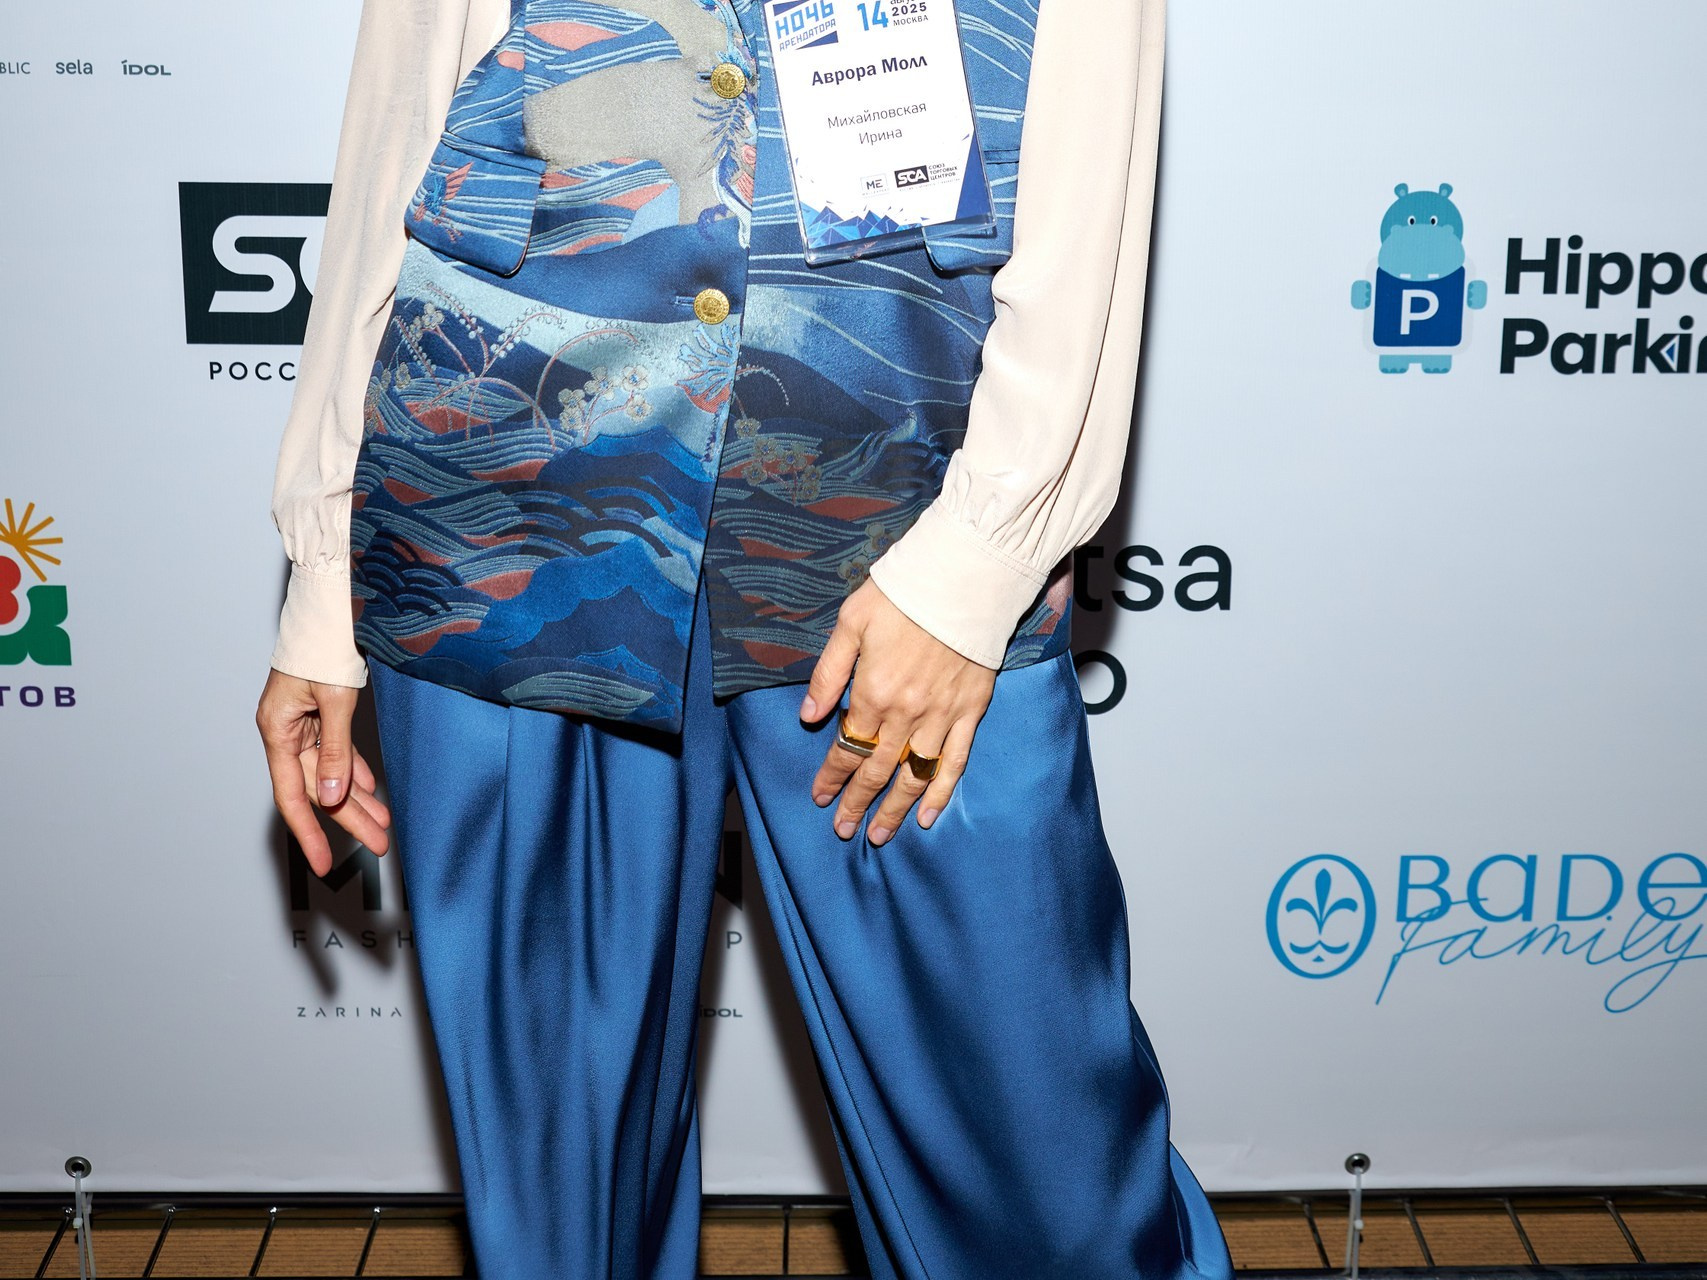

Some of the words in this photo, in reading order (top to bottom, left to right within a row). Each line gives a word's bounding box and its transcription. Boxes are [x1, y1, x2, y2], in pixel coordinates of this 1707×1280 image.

[857, 0, 889, 31] 14
[891, 2, 927, 17] 2025
[893, 15, 929, 26] МОСКВА
[779, 18, 836, 52] АРЕНДАТОРА
[56, 59, 93, 75] sela
[811, 63, 877, 86] Аврора
[881, 55, 928, 73] Молл
[827, 102, 927, 129] Михайловская
[859, 128, 903, 146] Ирина
[896, 168, 928, 186] SCA
[1400, 289, 1439, 335] P
[1500, 315, 1707, 375] Parki
[293, 931, 414, 948] FASH
[1376, 897, 1707, 1013] family
[297, 1007, 402, 1017] ZARINA
